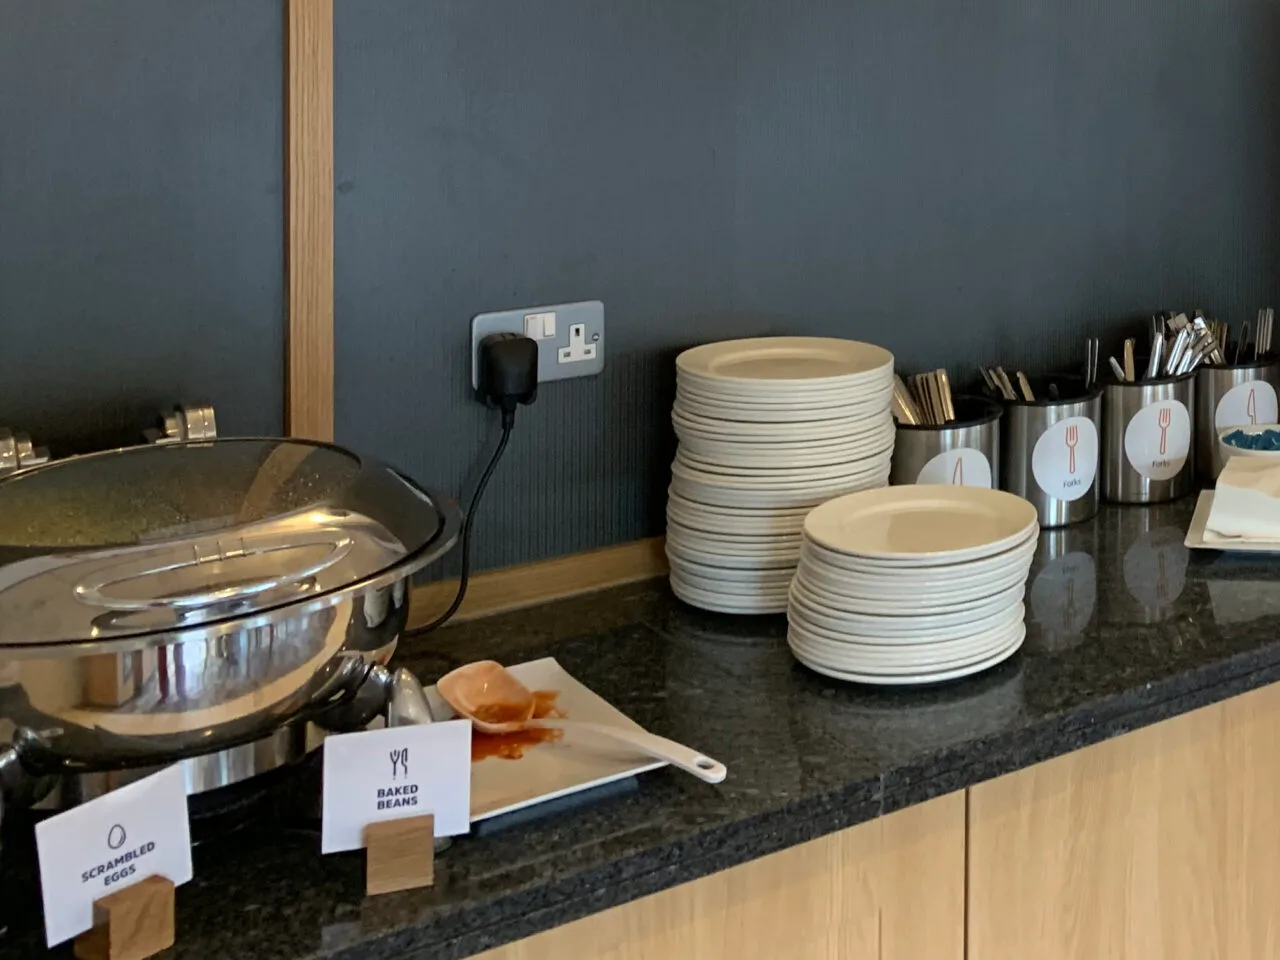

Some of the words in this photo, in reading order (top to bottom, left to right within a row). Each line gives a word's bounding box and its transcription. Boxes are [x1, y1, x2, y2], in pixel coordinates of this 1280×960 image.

[1153, 459, 1172, 468] Forks
[1063, 478, 1081, 488] Forks
[376, 784, 419, 799] BAKED
[377, 796, 418, 810] BEANS
[81, 841, 156, 883] SCRAMBLED
[103, 864, 137, 886] EGGS
